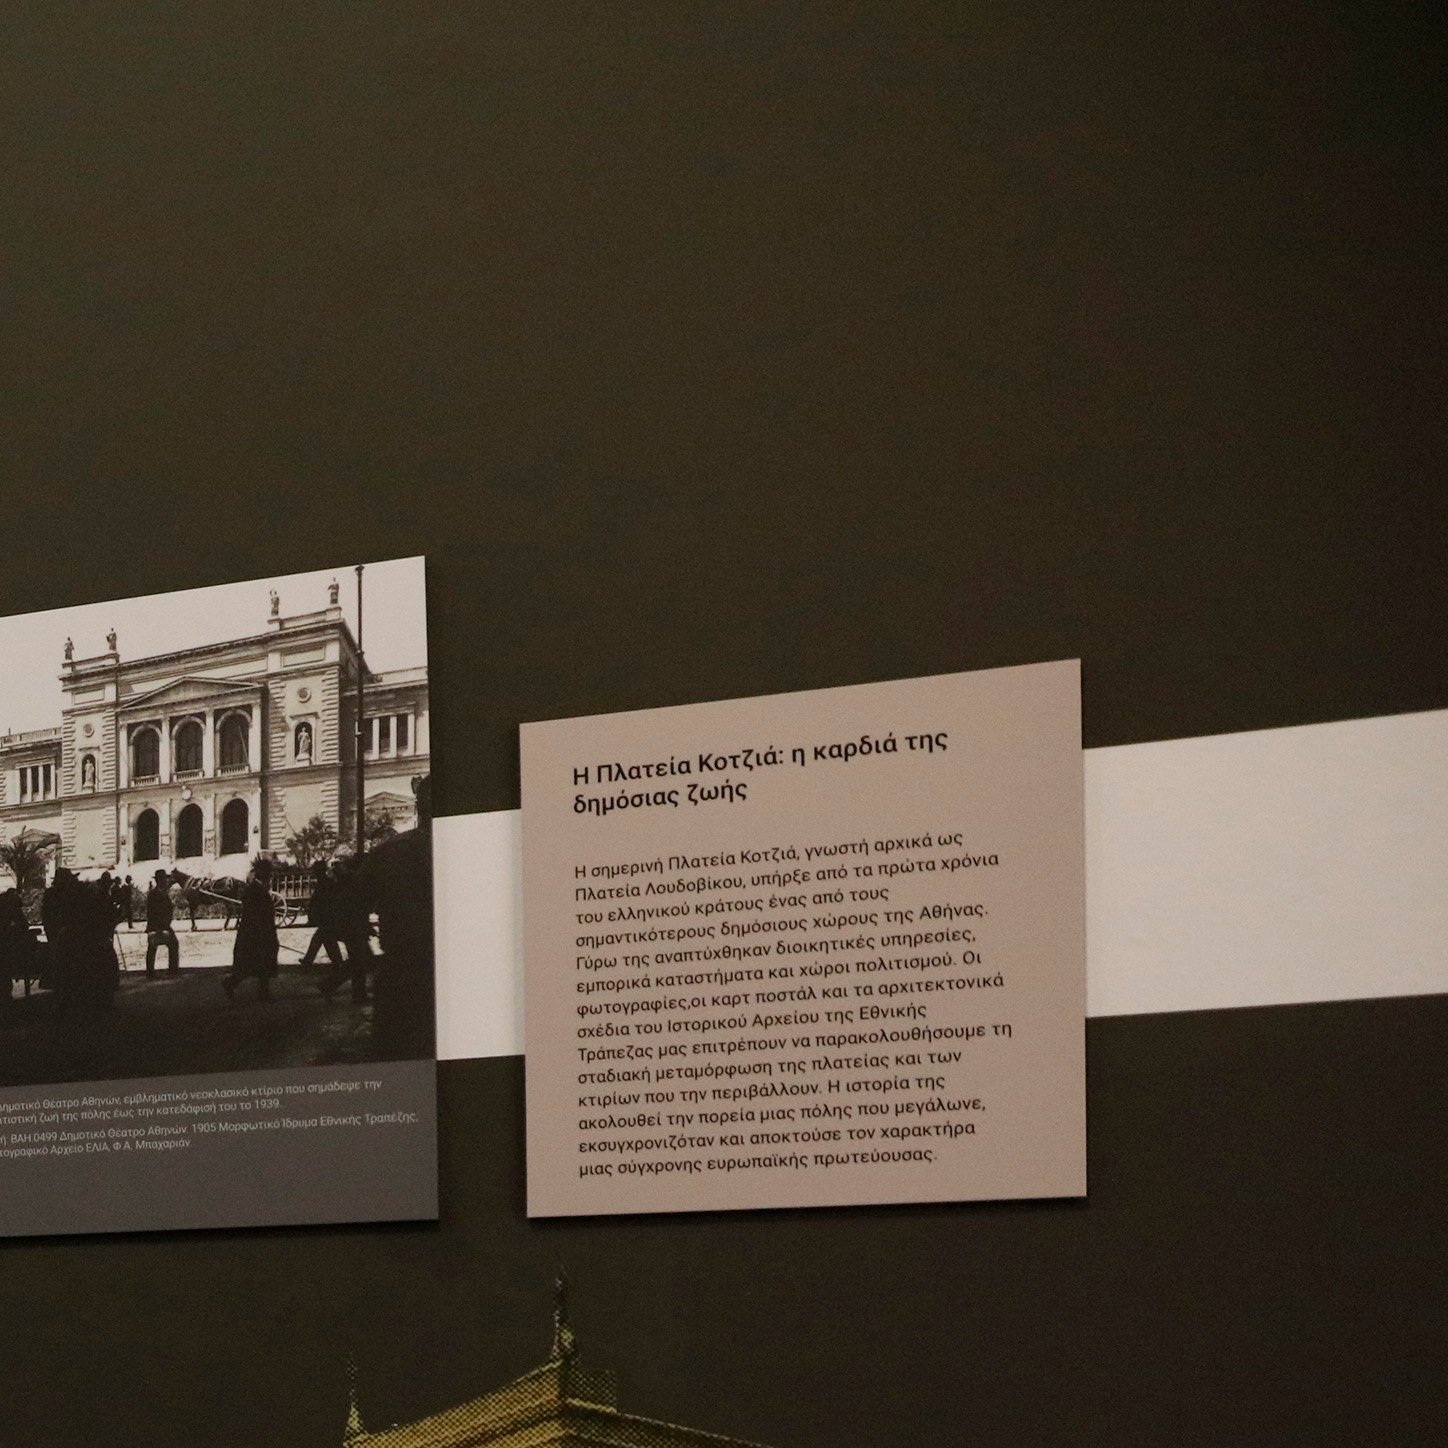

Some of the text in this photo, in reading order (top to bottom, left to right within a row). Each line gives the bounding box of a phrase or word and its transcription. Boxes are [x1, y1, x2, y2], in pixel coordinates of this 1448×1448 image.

[573, 731, 949, 786] Η Πλατεία Κοτζιά: η καρδιά της
[573, 778, 748, 817] δημόσιας ζωής
[574, 832, 963, 880] Η σημερινή Πλατεία Κοτζιά, γνωστή αρχικά ως
[575, 853, 1000, 902] Πλατεία Λουδοβίκου, υπήρξε από τα πρώτα χρόνια
[575, 888, 890, 925] του ελληνικού κράτους ένας από τους
[575, 903, 989, 950] σημαντικότερους δημόσιους χώρους της Αθήνας.
[42, 1098, 80, 1110] Θέατρο
[251, 1085, 284, 1098] κτίριο
[285, 1084, 306, 1094] που
[363, 1079, 383, 1090] την
[137, 1107, 154, 1117] την
[218, 1101, 237, 1112] του
[239, 1101, 252, 1111] το
[192, 1123, 217, 1133] 1905
[319, 1115, 361, 1127] Εθνικής
